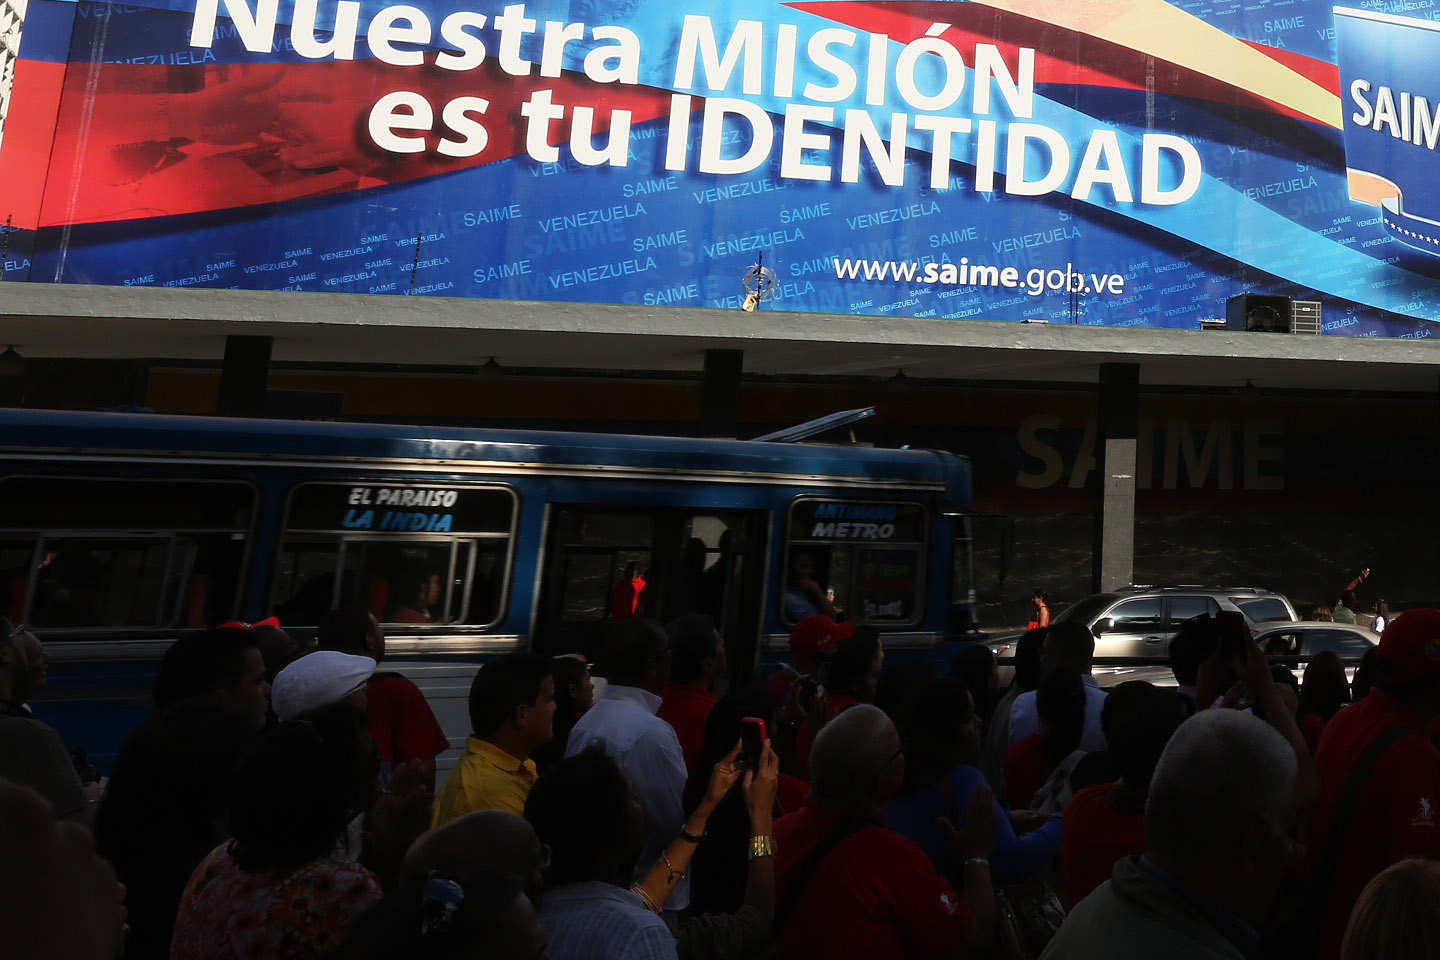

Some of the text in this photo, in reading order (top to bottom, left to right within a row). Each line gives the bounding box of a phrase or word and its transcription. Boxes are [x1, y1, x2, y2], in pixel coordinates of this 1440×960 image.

[1264, 16, 1305, 33] SAIME
[672, 23, 1036, 119] MISIÓN
[367, 91, 490, 157] es
[521, 90, 632, 168] tu
[664, 93, 1202, 206] IDENTIDAD
[623, 176, 677, 198] SAIME
[693, 178, 794, 204] VENEZUELA
[464, 204, 522, 227] SAIME
[539, 202, 647, 233] VENEZUELA
[780, 202, 831, 225] SAIME
[846, 202, 941, 231] VENEZUELA
[1333, 216, 1351, 225] SAIME
[361, 233, 388, 245] SAIME
[633, 229, 688, 252] SAIME
[704, 228, 805, 258] VENEZUELA
[929, 227, 978, 248] SAIME
[992, 226, 1081, 254] VENEZUELA
[1361, 236, 1396, 248] VENEZUELA
[285, 248, 313, 259] SAIME
[320, 246, 373, 261] VENEZUELA
[206, 259, 236, 272] SAIME
[243, 260, 299, 274] VENEZUELA
[365, 258, 392, 270] SAIME
[1129, 261, 1149, 272] SAIME
[1154, 261, 1192, 274] VENEZUELA
[289, 272, 317, 284] SAIME
[324, 271, 377, 286] VENEZUELA
[474, 260, 531, 284] SAIME
[549, 256, 657, 289] VENEZUELA
[833, 256, 1124, 297] www.saime.gob.ve
[1186, 271, 1205, 282] SAIME
[124, 274, 154, 287] SAIME
[162, 273, 220, 287] VENEZUELA
[369, 283, 396, 294] SAIME
[643, 284, 699, 307] SAIME
[910, 286, 931, 297] SAIME
[937, 285, 978, 300] VENEZUELA
[1134, 283, 1153, 294] SAIME
[1159, 282, 1197, 295] VENEZUELA
[850, 299, 873, 311] SAIME
[879, 297, 920, 313] VENEZUELA
[960, 297, 981, 308] SAIME
[988, 296, 1029, 311] VENEZUELA
[1105, 294, 1143, 308] VENEZUELA
[1191, 293, 1211, 303] SAIME
[1138, 304, 1159, 315] SAIME
[1164, 303, 1201, 317] VENEZUELA
[348, 487, 459, 508] EL PARAISO
[341, 508, 455, 532] LA INDIA
[810, 522, 896, 539] METRO
